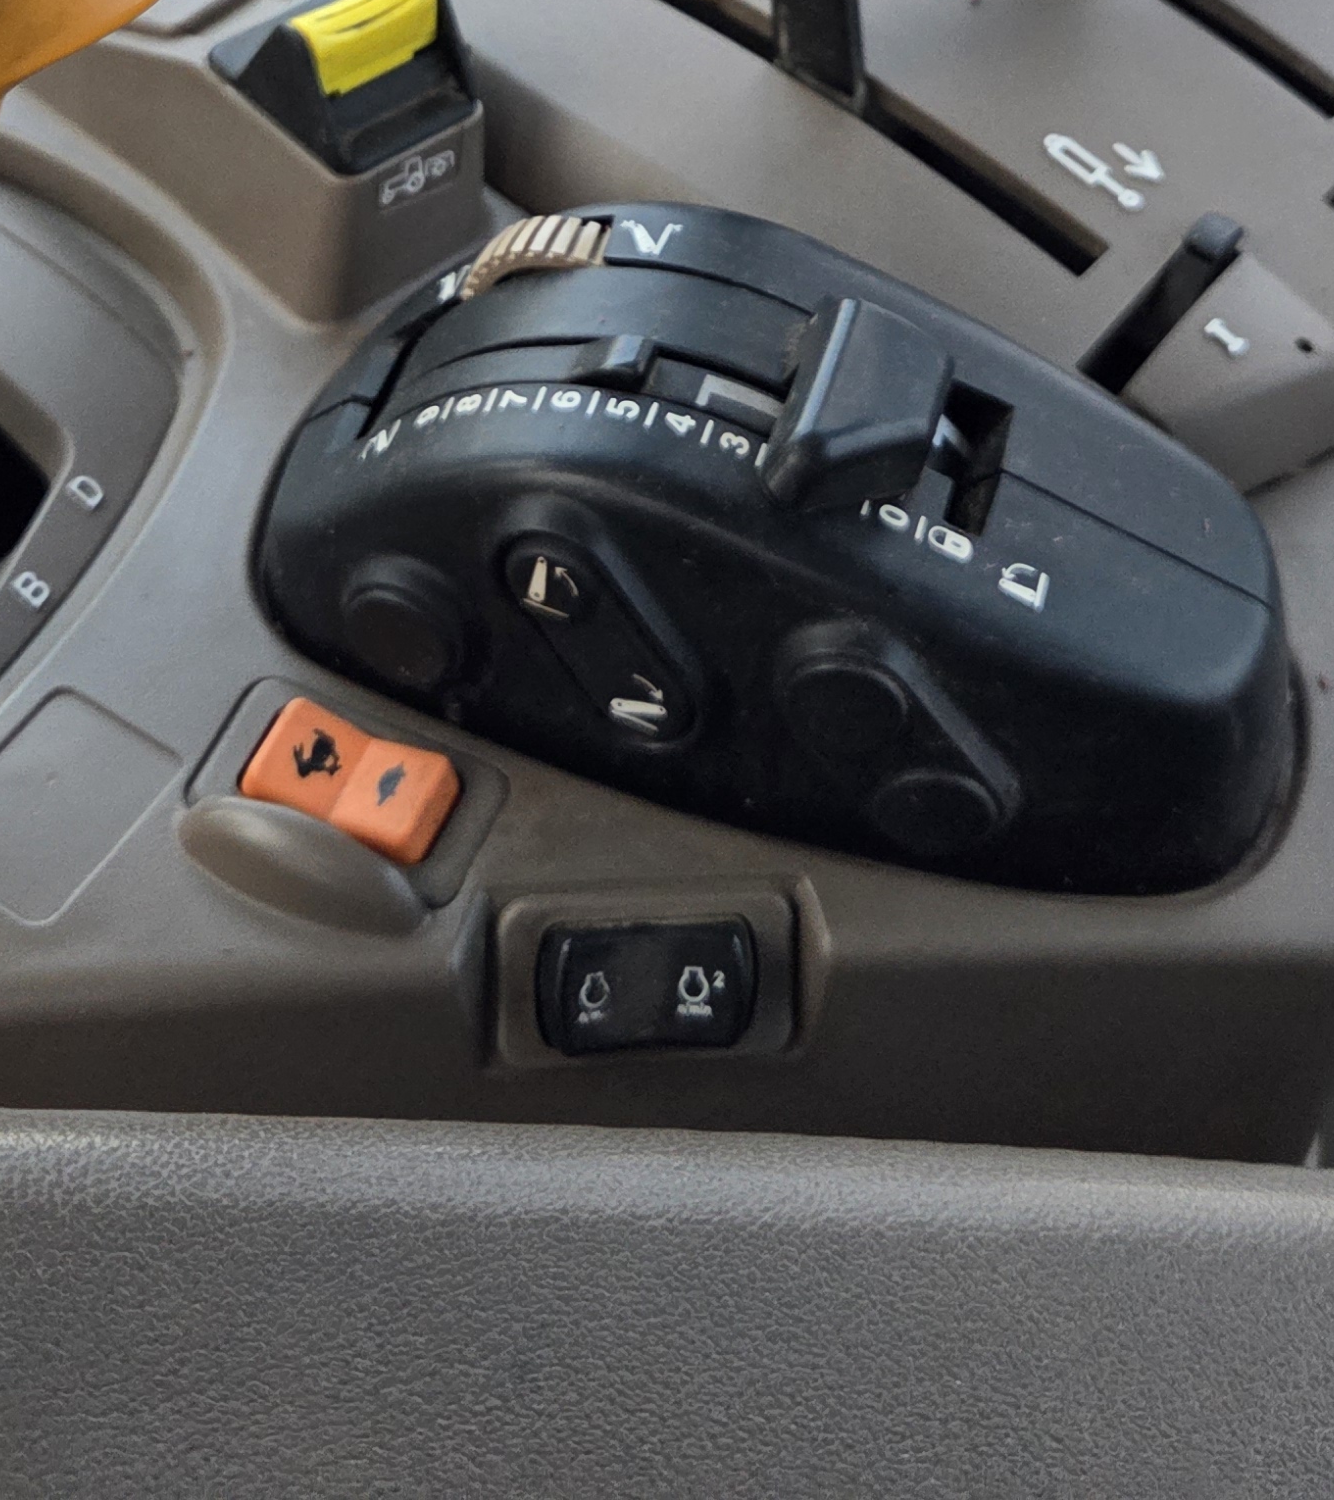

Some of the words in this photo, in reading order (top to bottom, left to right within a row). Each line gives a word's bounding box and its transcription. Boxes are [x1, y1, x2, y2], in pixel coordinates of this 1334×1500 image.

[455, 392, 483, 415] 8
[498, 388, 528, 411] 7
[551, 389, 581, 411] 6
[607, 397, 641, 421] 5
[665, 411, 697, 436] 4
[720, 430, 750, 457] 3
[878, 503, 910, 531] 0
[66, 474, 104, 509] D
[12, 570, 50, 607] B
[712, 970, 726, 989] 2
